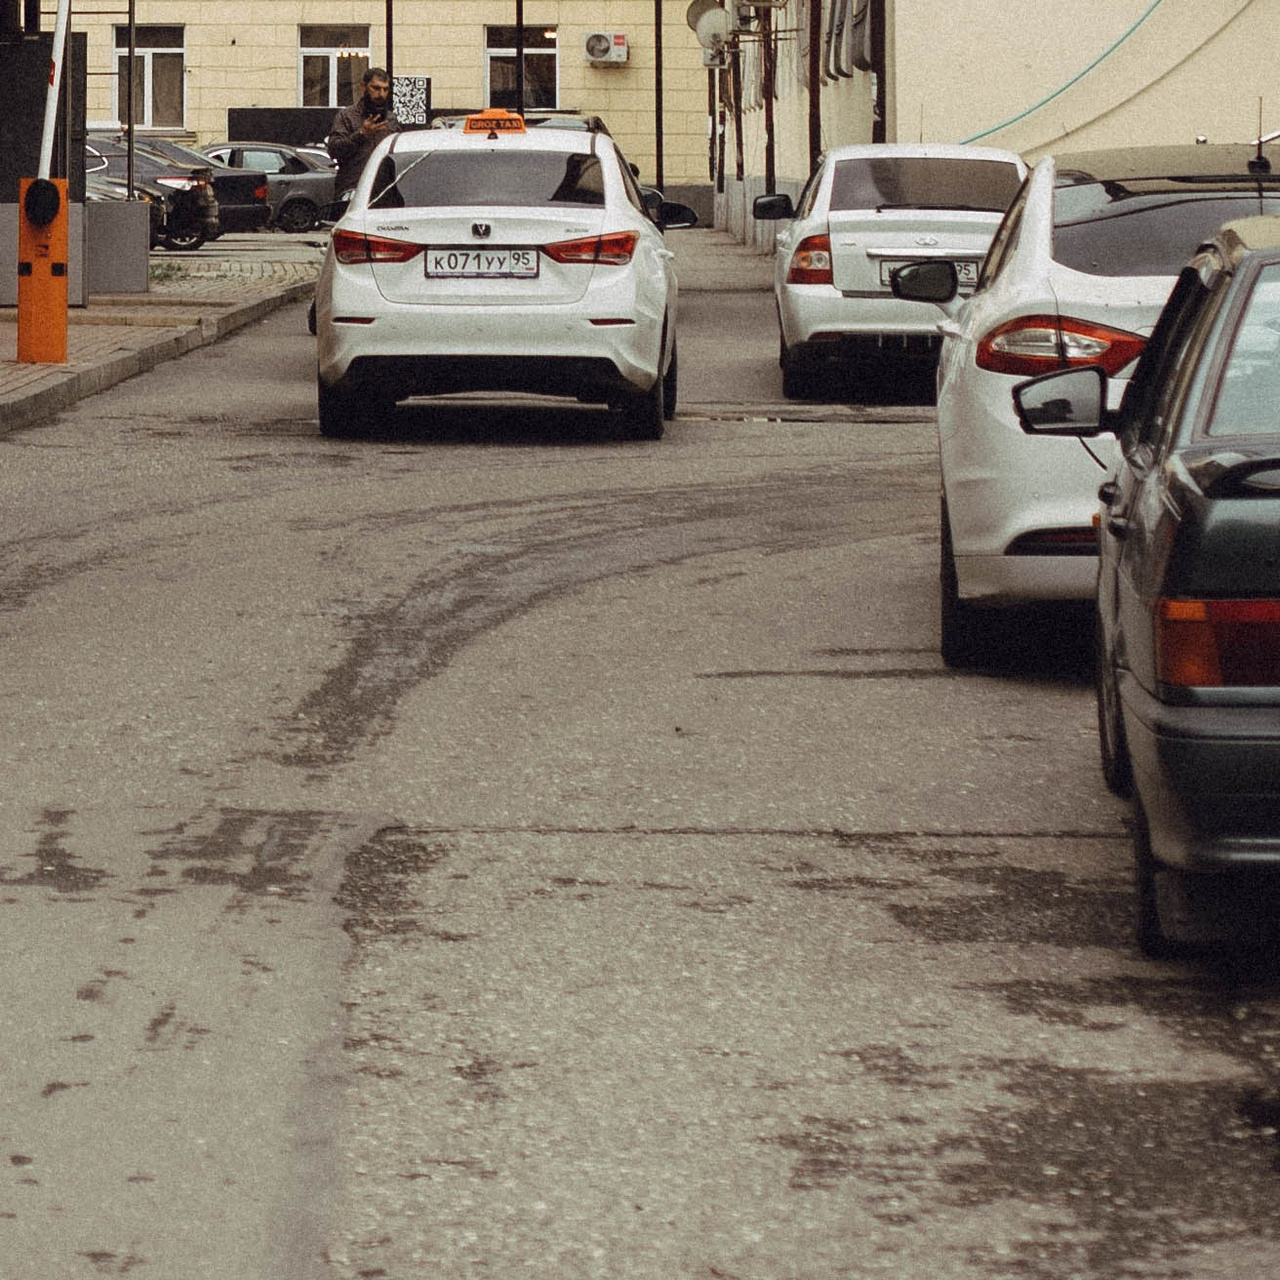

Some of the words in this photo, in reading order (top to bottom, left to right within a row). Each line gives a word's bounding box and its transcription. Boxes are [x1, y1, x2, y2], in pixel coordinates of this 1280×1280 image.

[499, 120, 521, 129] TAXI
[434, 253, 507, 271] К071УУ
[512, 252, 531, 266] 95
